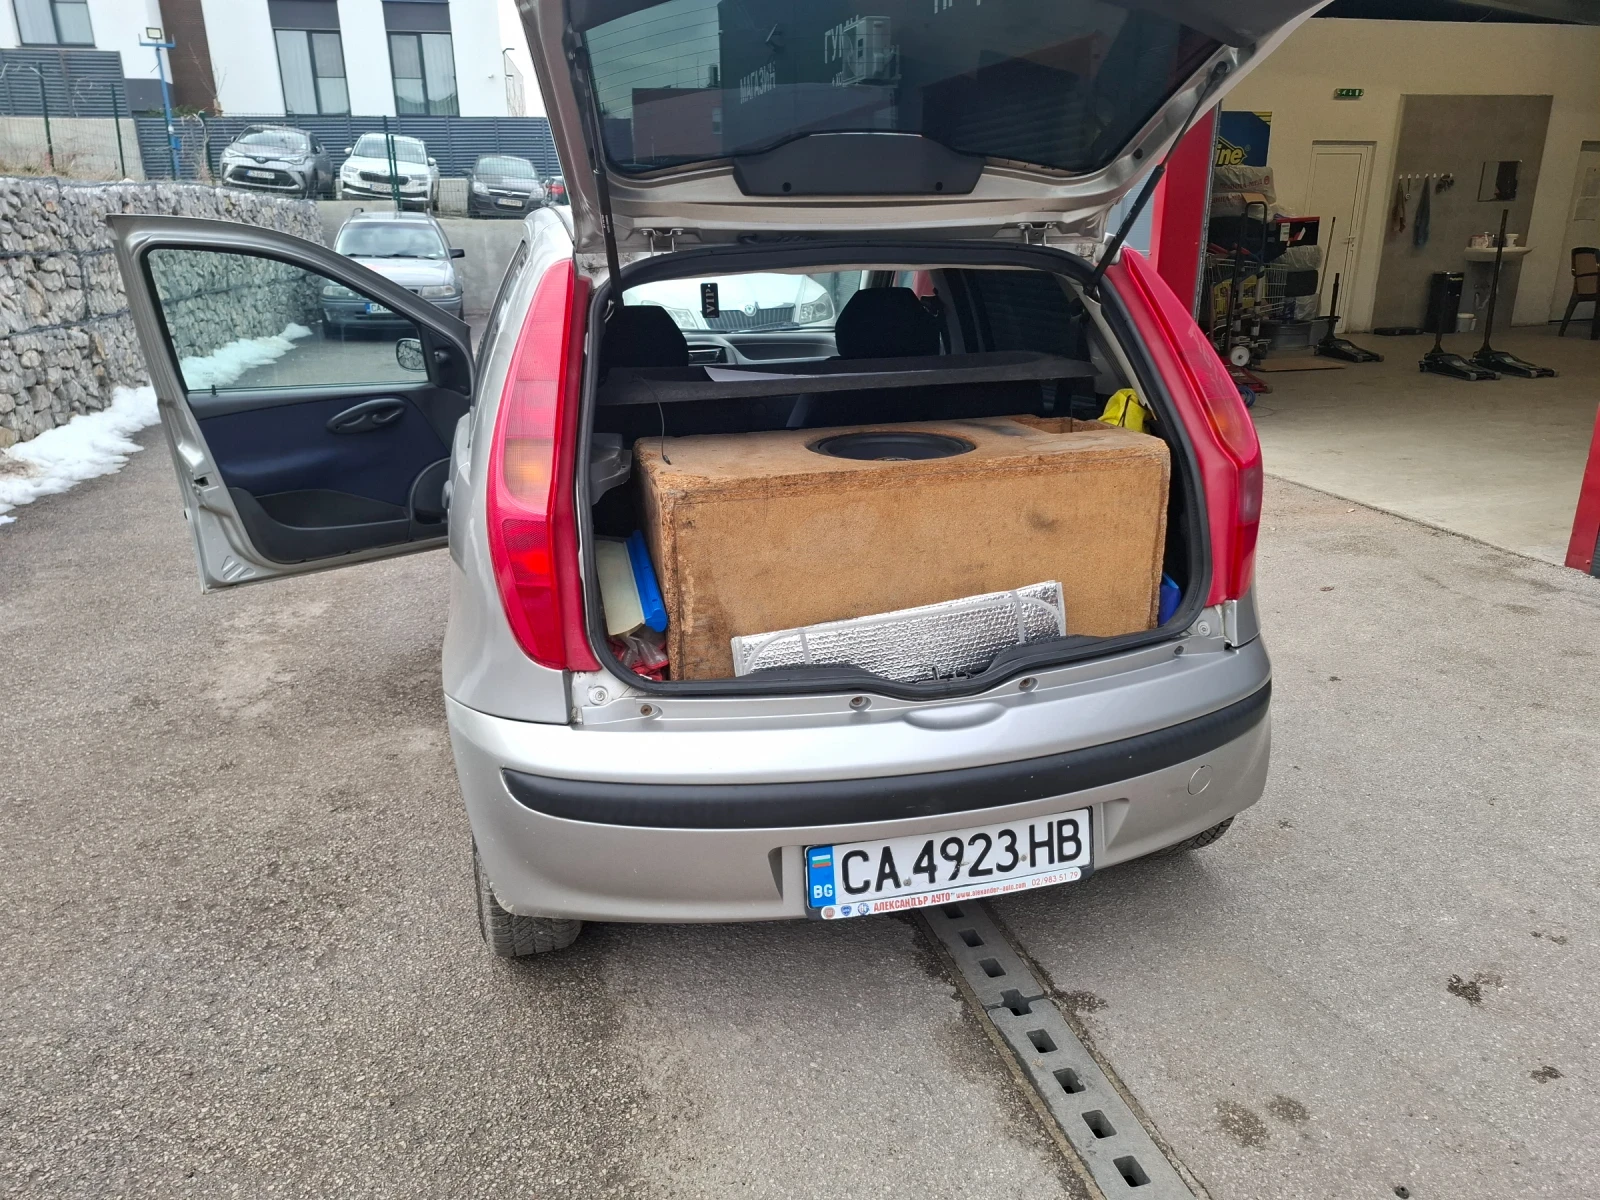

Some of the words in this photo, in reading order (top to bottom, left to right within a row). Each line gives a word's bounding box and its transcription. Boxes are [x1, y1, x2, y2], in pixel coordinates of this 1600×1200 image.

[740, 62, 776, 104] МАГАЗИН
[913, 828, 1020, 884] 4923
[1031, 876, 1057, 887] 02/983
[1058, 873, 1067, 881] 51
[1069, 871, 1079, 879] 79
[813, 884, 833, 898] BG
[956, 881, 1027, 899] www.alexander-auto.com
[873, 896, 929, 913] АЛЕКСАНДЪР
[931, 892, 951, 905] АУТО
